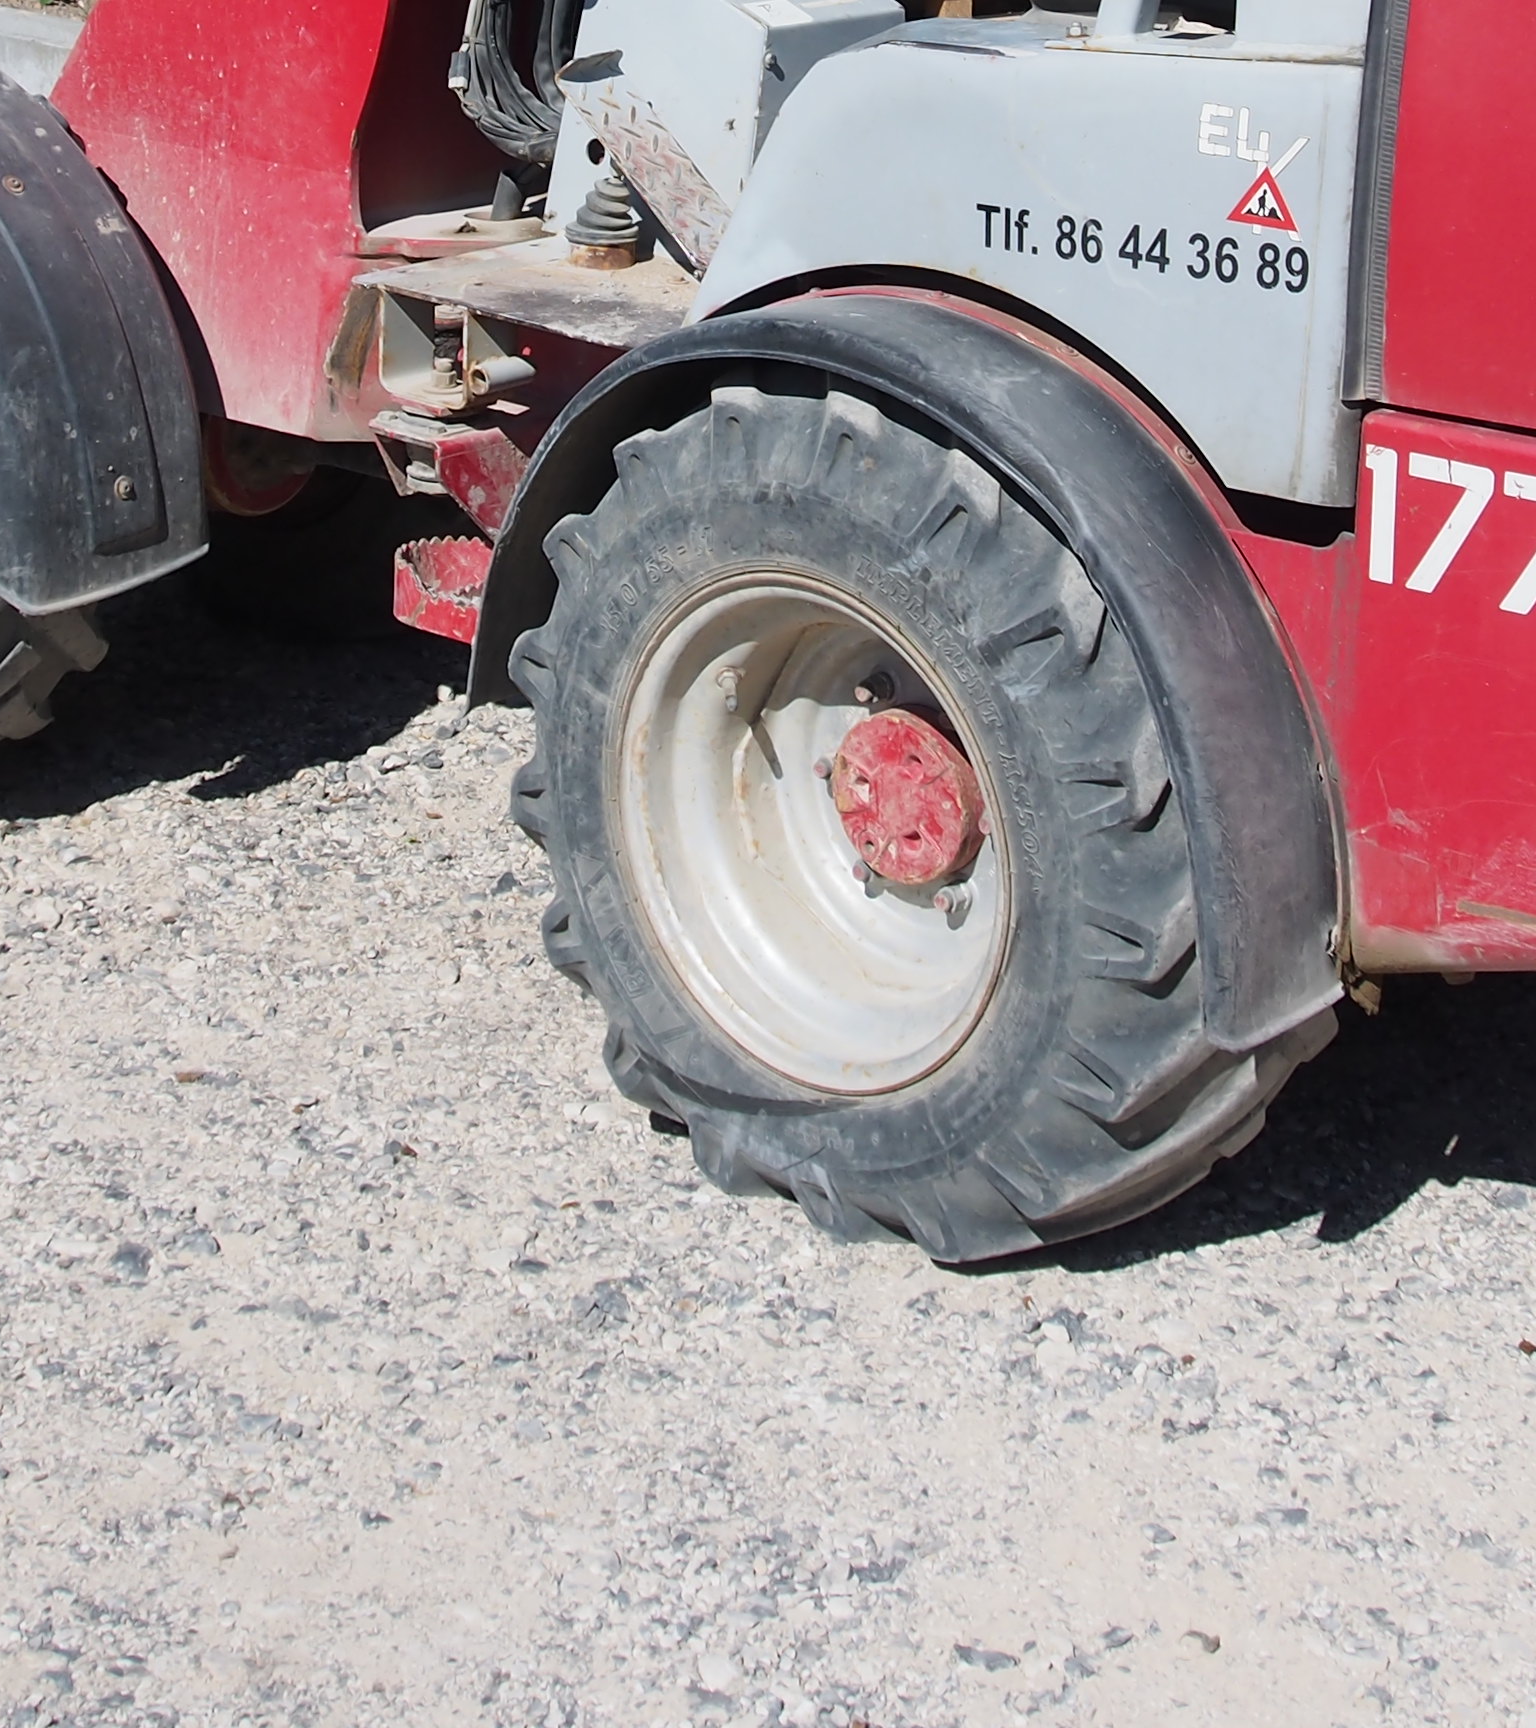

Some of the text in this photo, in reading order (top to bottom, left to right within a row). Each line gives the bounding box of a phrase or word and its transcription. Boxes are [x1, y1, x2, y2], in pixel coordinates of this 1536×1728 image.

[976, 203, 1310, 294] Tlf. 86 44 36 89
